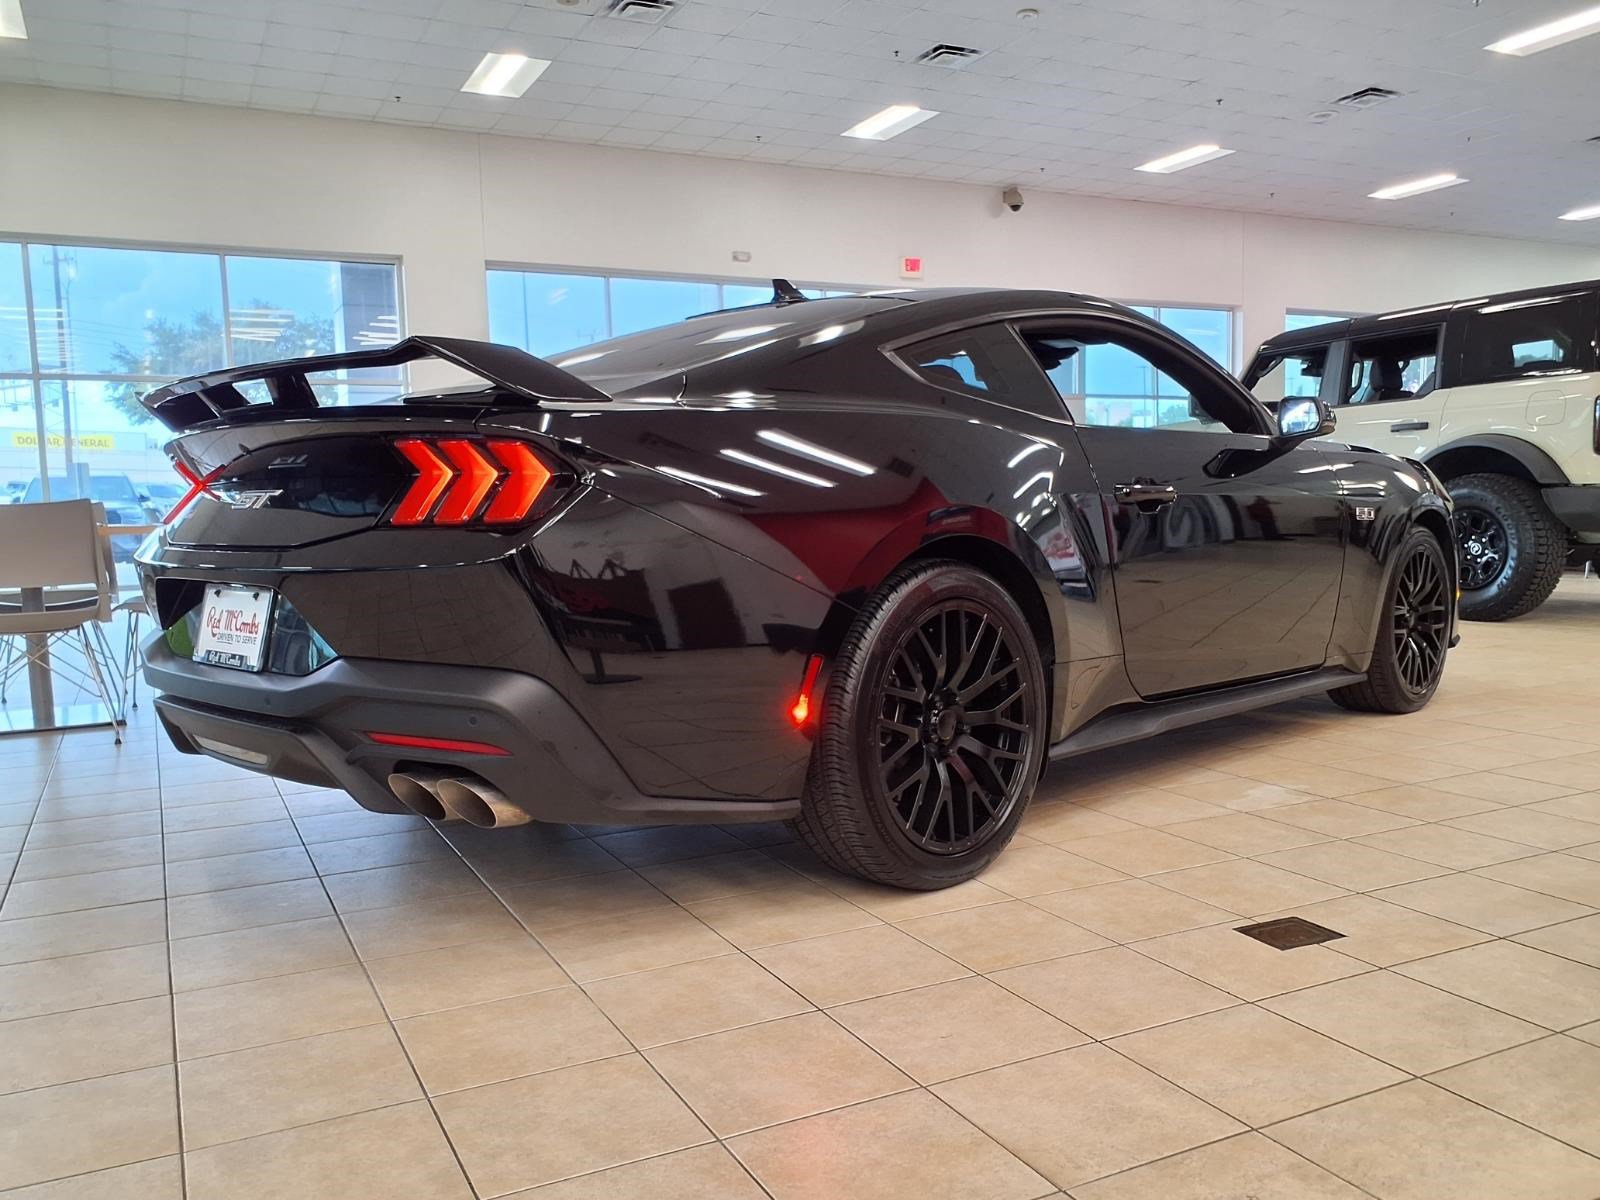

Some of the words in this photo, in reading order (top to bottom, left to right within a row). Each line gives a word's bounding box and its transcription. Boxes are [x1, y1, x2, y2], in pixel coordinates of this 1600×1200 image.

[17, 436, 61, 447] DOLAR
[232, 489, 284, 509] GT
[206, 606, 224, 638] Red
[217, 632, 234, 642] DRIVEN
[235, 634, 242, 643] TO
[241, 635, 258, 645] SERVE
